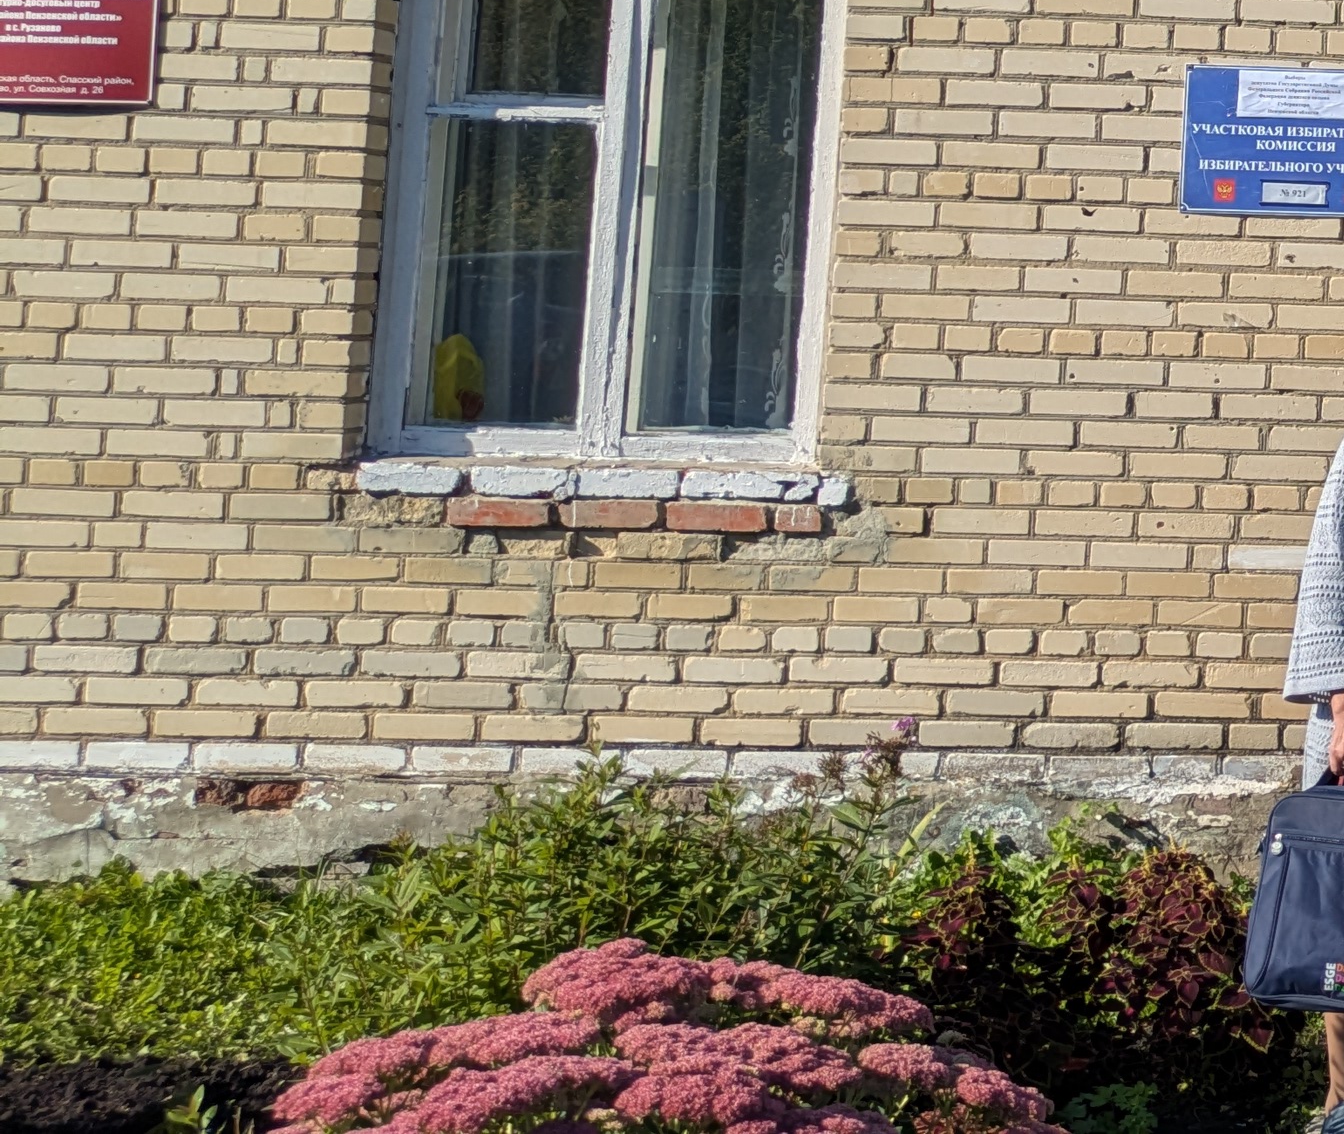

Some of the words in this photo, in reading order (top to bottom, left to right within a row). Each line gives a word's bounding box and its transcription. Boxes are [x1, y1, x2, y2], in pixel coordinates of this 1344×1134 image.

[74, 0, 101, 8] центр
[81, 36, 119, 45] области
[59, 75, 102, 84] Спасский
[28, 85, 76, 93] Совхозная
[1192, 123, 1283, 137] УЧАСТКОВАЯ
[1256, 140, 1336, 152] КОМИССИЯ
[1199, 159, 1323, 173] ИЗБИРАТЕЛЬНОГО
[1292, 189, 1306, 198] 921
[1324, 962, 1336, 991] ESGE
